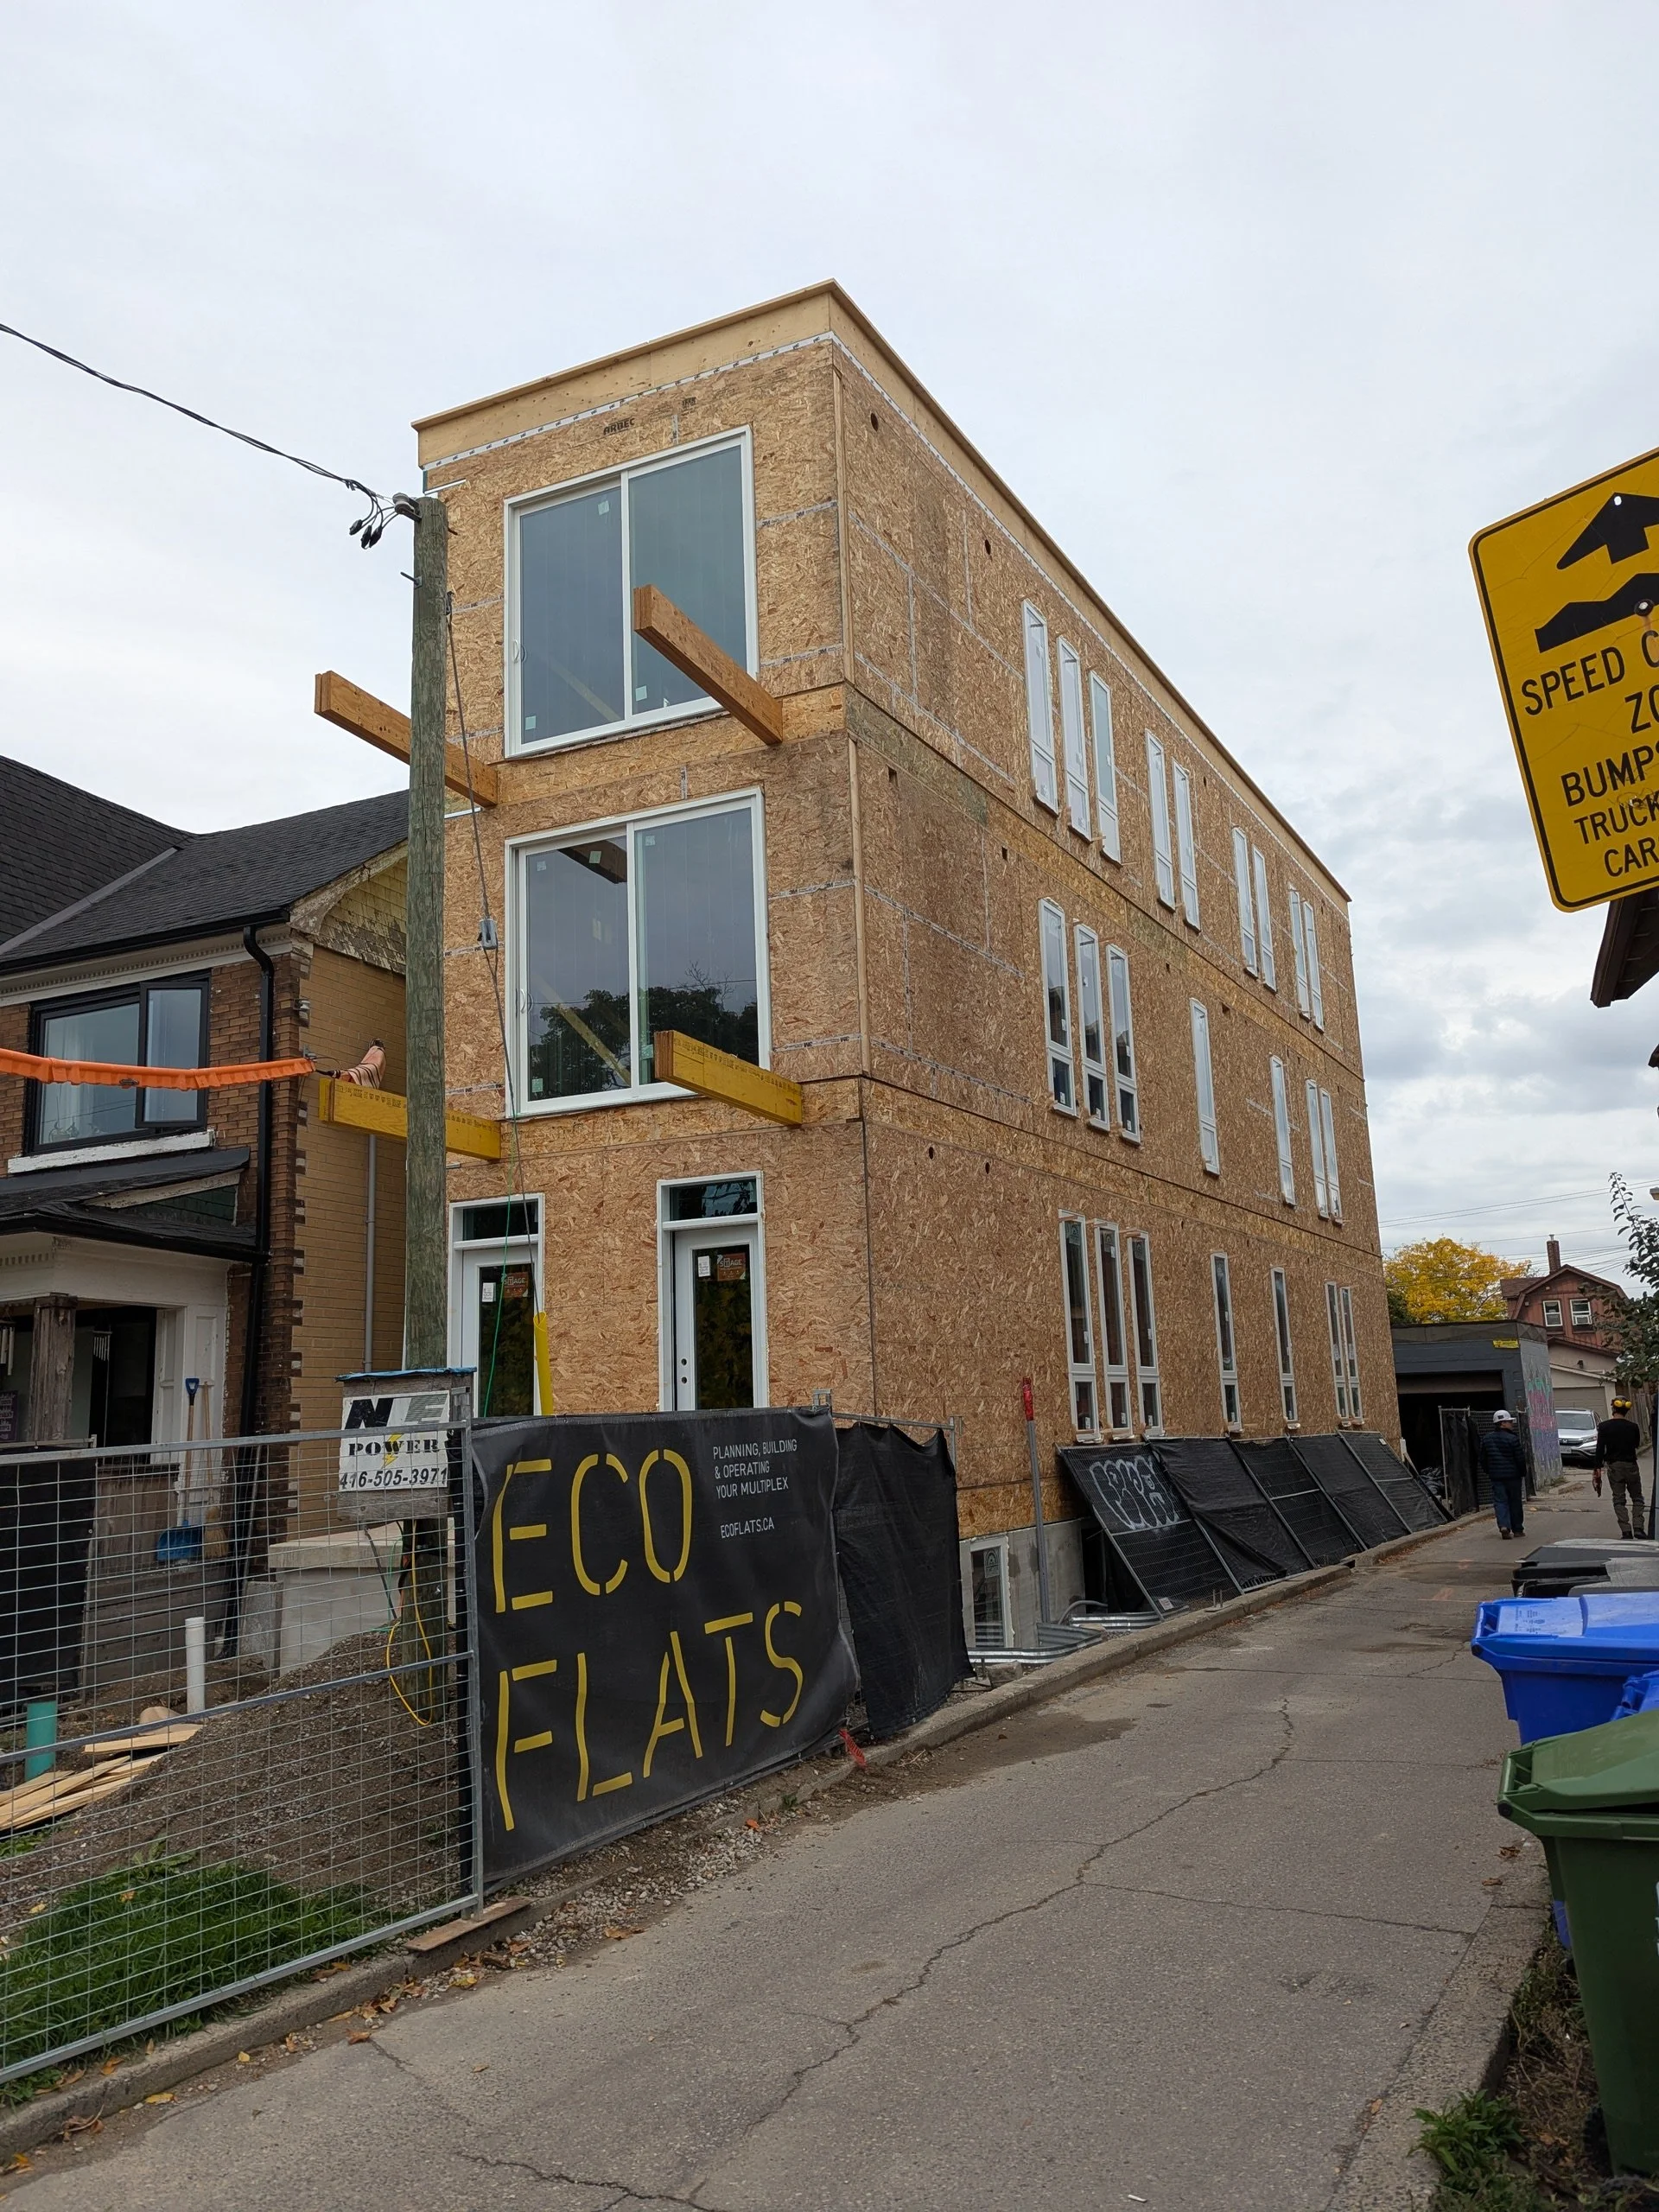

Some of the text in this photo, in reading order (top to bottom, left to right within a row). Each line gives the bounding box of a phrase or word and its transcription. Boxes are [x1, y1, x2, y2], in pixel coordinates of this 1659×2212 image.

[1522, 647, 1625, 715] SPEED
[1561, 741, 1659, 807] BUMP
[348, 1440, 439, 1456] POWER
[762, 1439, 798, 1455] BUILDING
[340, 1468, 448, 1489] 416-505-3971
[715, 1460, 770, 1479] & OPERATING
[715, 1477, 789, 1499] YOUR MULTIPLEX
[493, 1450, 692, 1612] ECO
[720, 1516, 775, 1539] ECOFLATS.CA
[496, 1601, 804, 1831] FLATS
